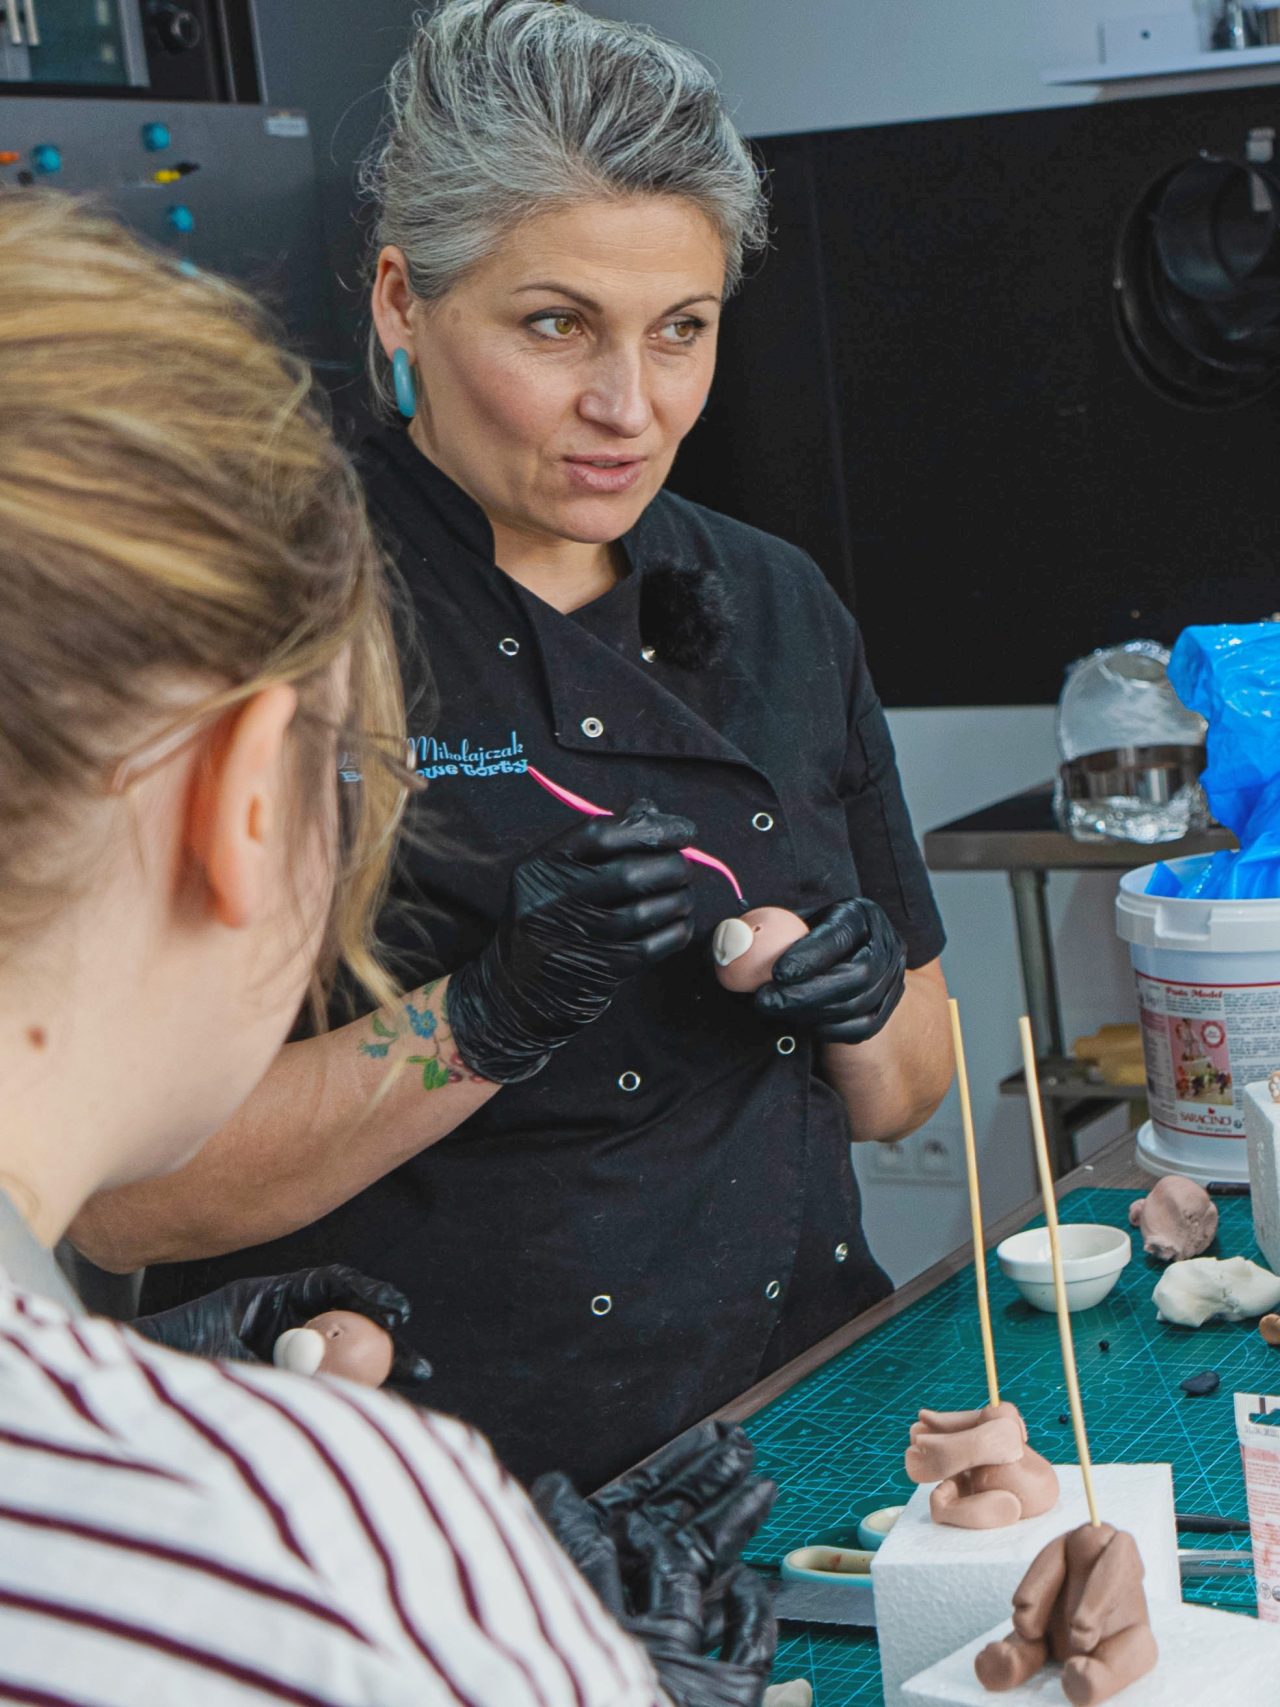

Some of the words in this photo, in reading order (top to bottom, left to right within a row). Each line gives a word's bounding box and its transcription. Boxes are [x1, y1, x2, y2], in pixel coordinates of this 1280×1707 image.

[406, 730, 524, 768] Mikołajczak
[459, 758, 529, 777] torty
[1191, 988, 1223, 999] Model
